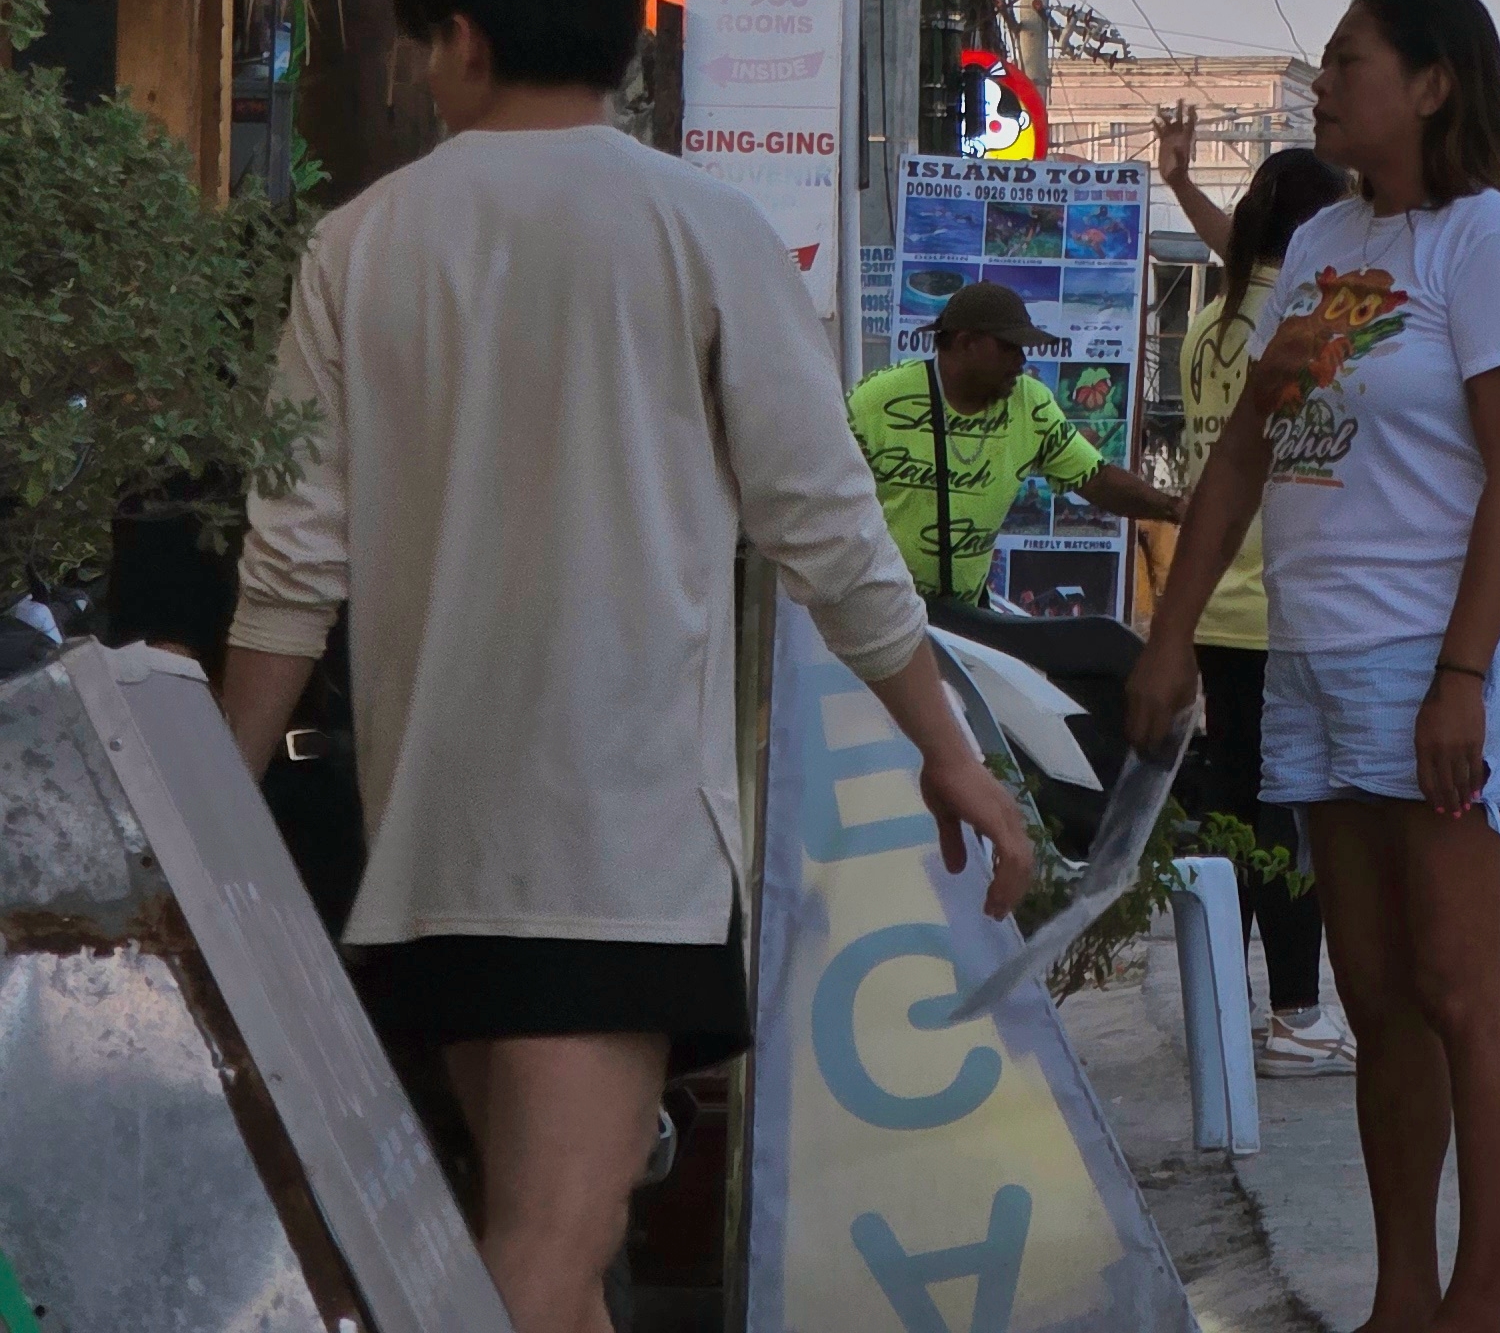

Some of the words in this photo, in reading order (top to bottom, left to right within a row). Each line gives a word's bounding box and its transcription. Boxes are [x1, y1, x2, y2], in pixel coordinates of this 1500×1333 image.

[716, 13, 813, 34] ROOMS
[731, 59, 808, 81] INSIDE
[685, 129, 834, 155] GING-GING
[906, 161, 1036, 183] ISLAND
[1046, 166, 1140, 185] TOUR
[906, 182, 963, 199] DODONG
[974, 186, 1005, 201] 0926
[1010, 188, 1033, 201] 036
[1037, 189, 1068, 203] 0102
[1024, 539, 1061, 549] FIREFLY
[1064, 540, 1112, 550] WATCHING
